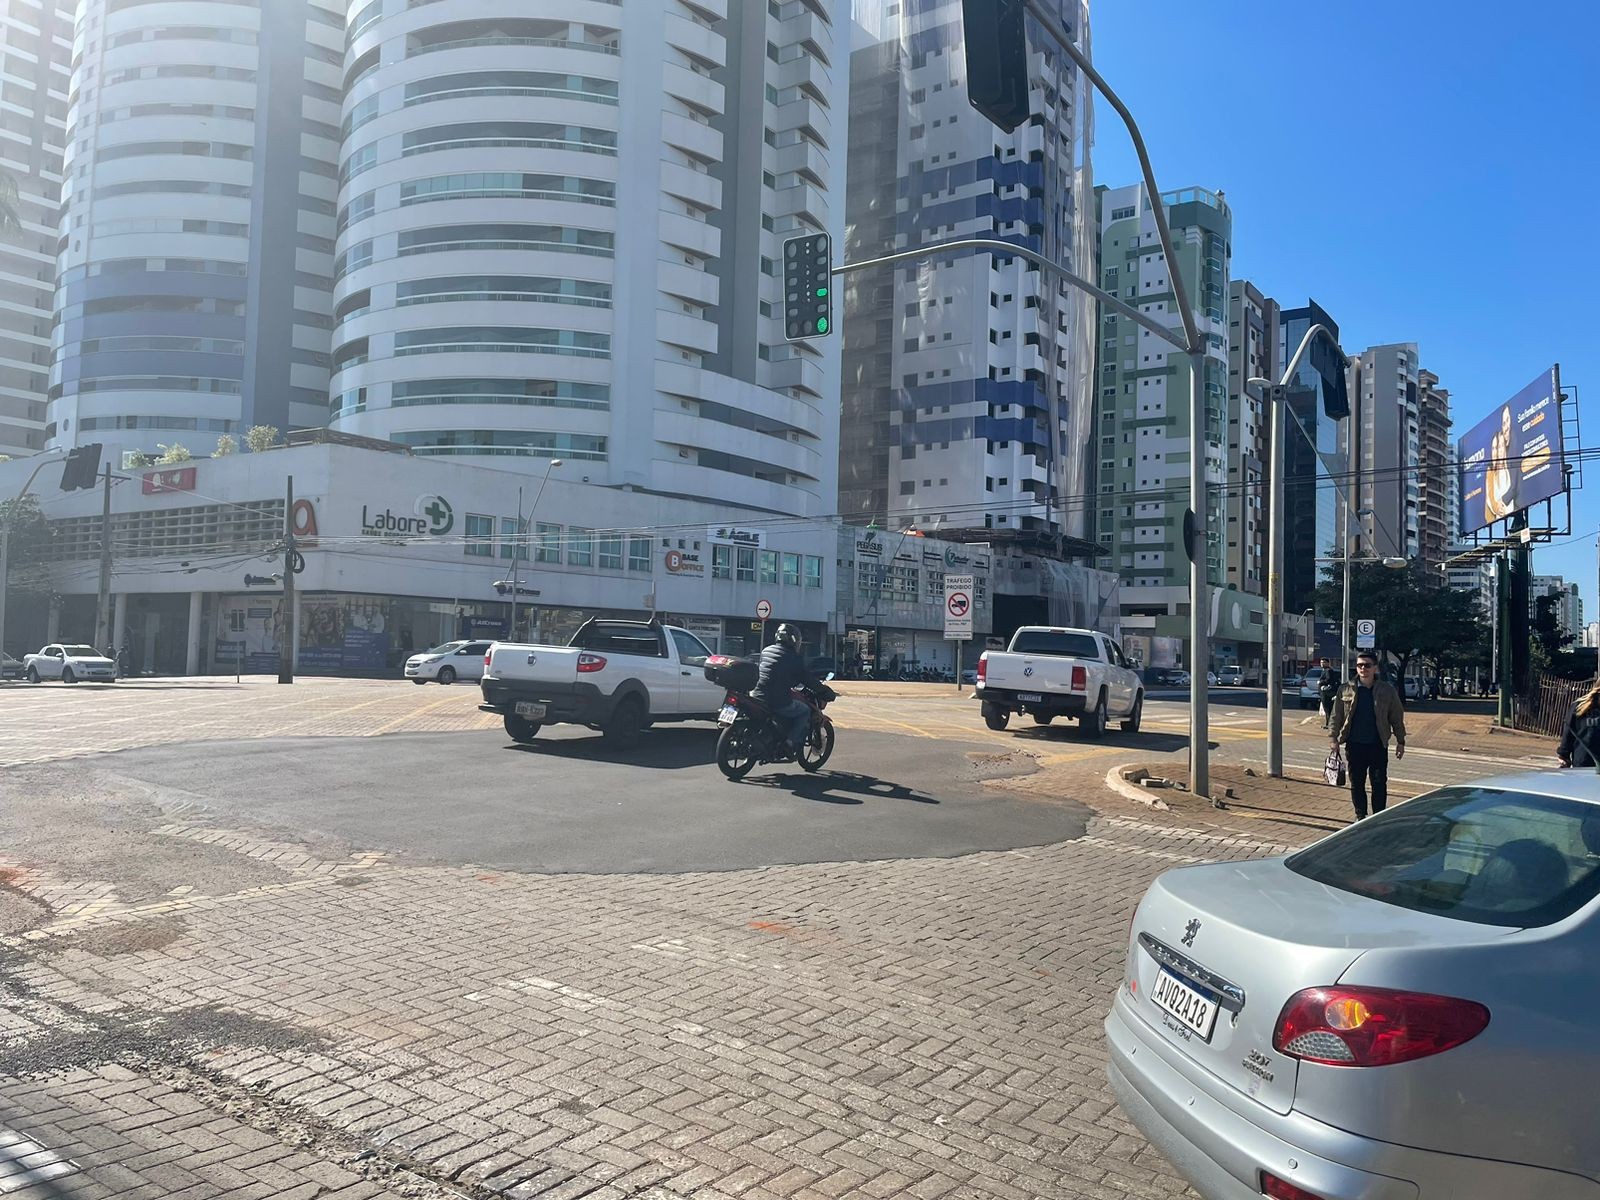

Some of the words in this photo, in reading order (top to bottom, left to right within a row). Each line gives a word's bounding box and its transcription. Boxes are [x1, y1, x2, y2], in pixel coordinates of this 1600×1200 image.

[362, 504, 427, 535] Labore
[681, 553, 699, 562] BASE
[1156, 976, 1208, 1029] AVQ2A18
